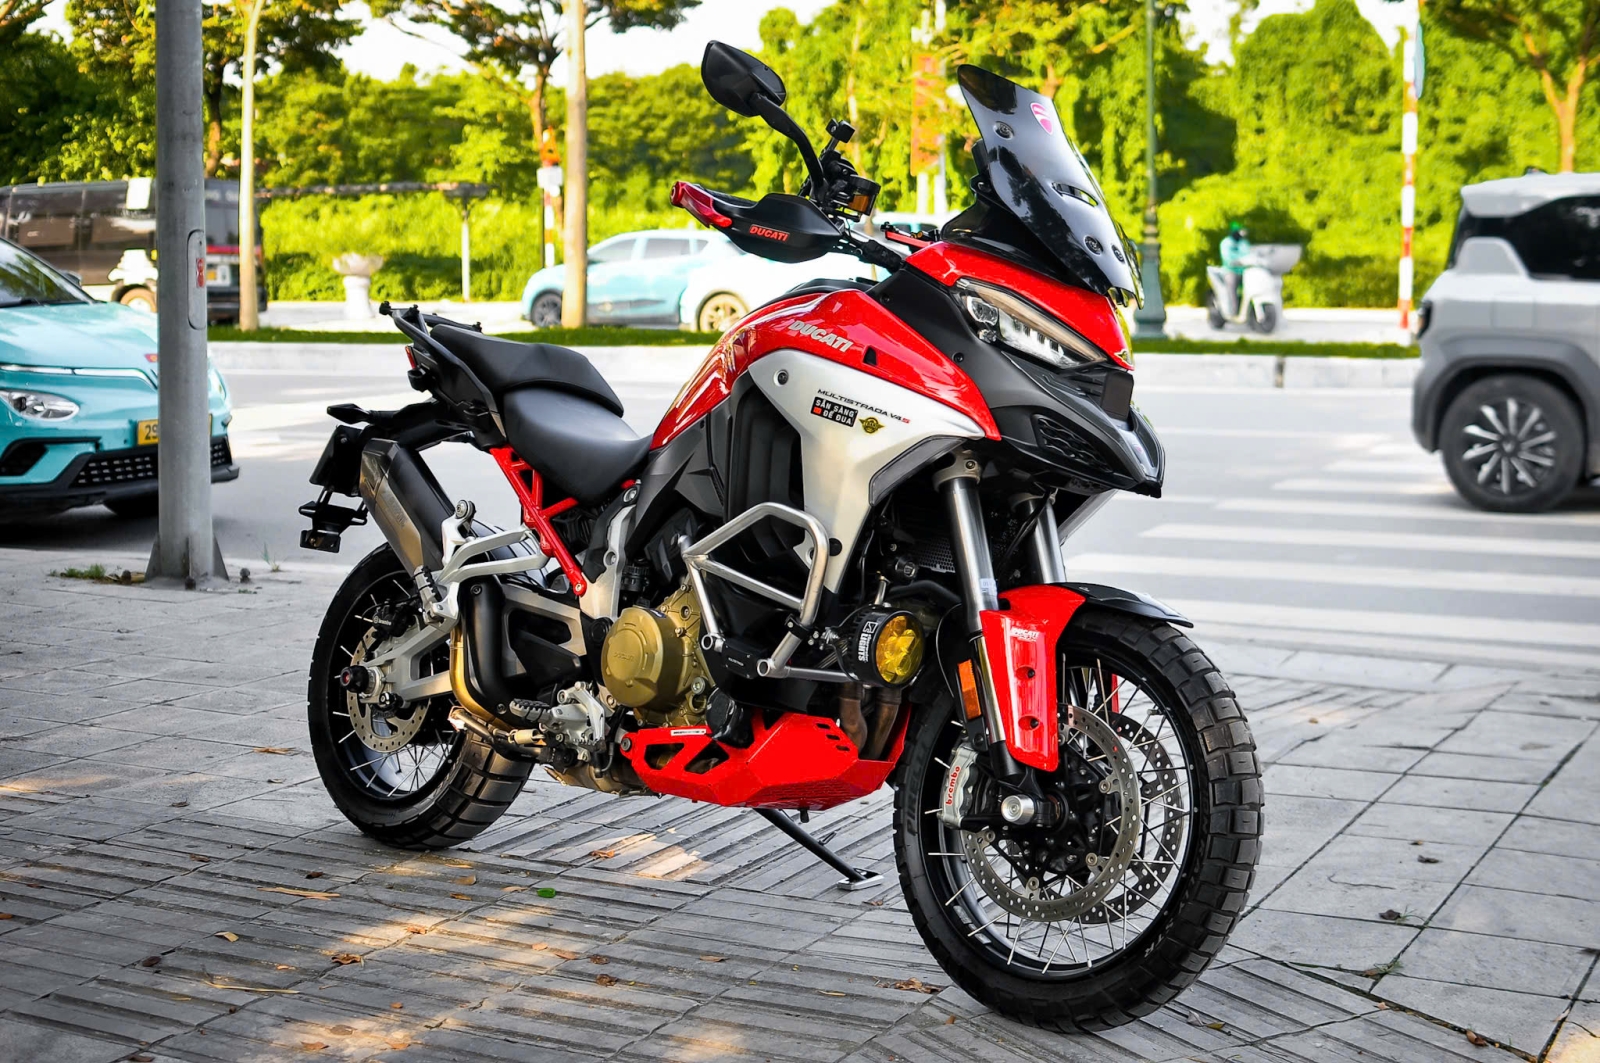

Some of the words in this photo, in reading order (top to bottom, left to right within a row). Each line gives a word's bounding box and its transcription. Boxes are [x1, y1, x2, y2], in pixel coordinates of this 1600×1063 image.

[750, 225, 789, 242] DUCATI
[788, 320, 854, 353] DUCATI
[817, 389, 889, 417] MULTISTRADA
[889, 412, 911, 425] V4S
[857, 632, 869, 662] LIGHTS
[945, 765, 962, 807] brembo
